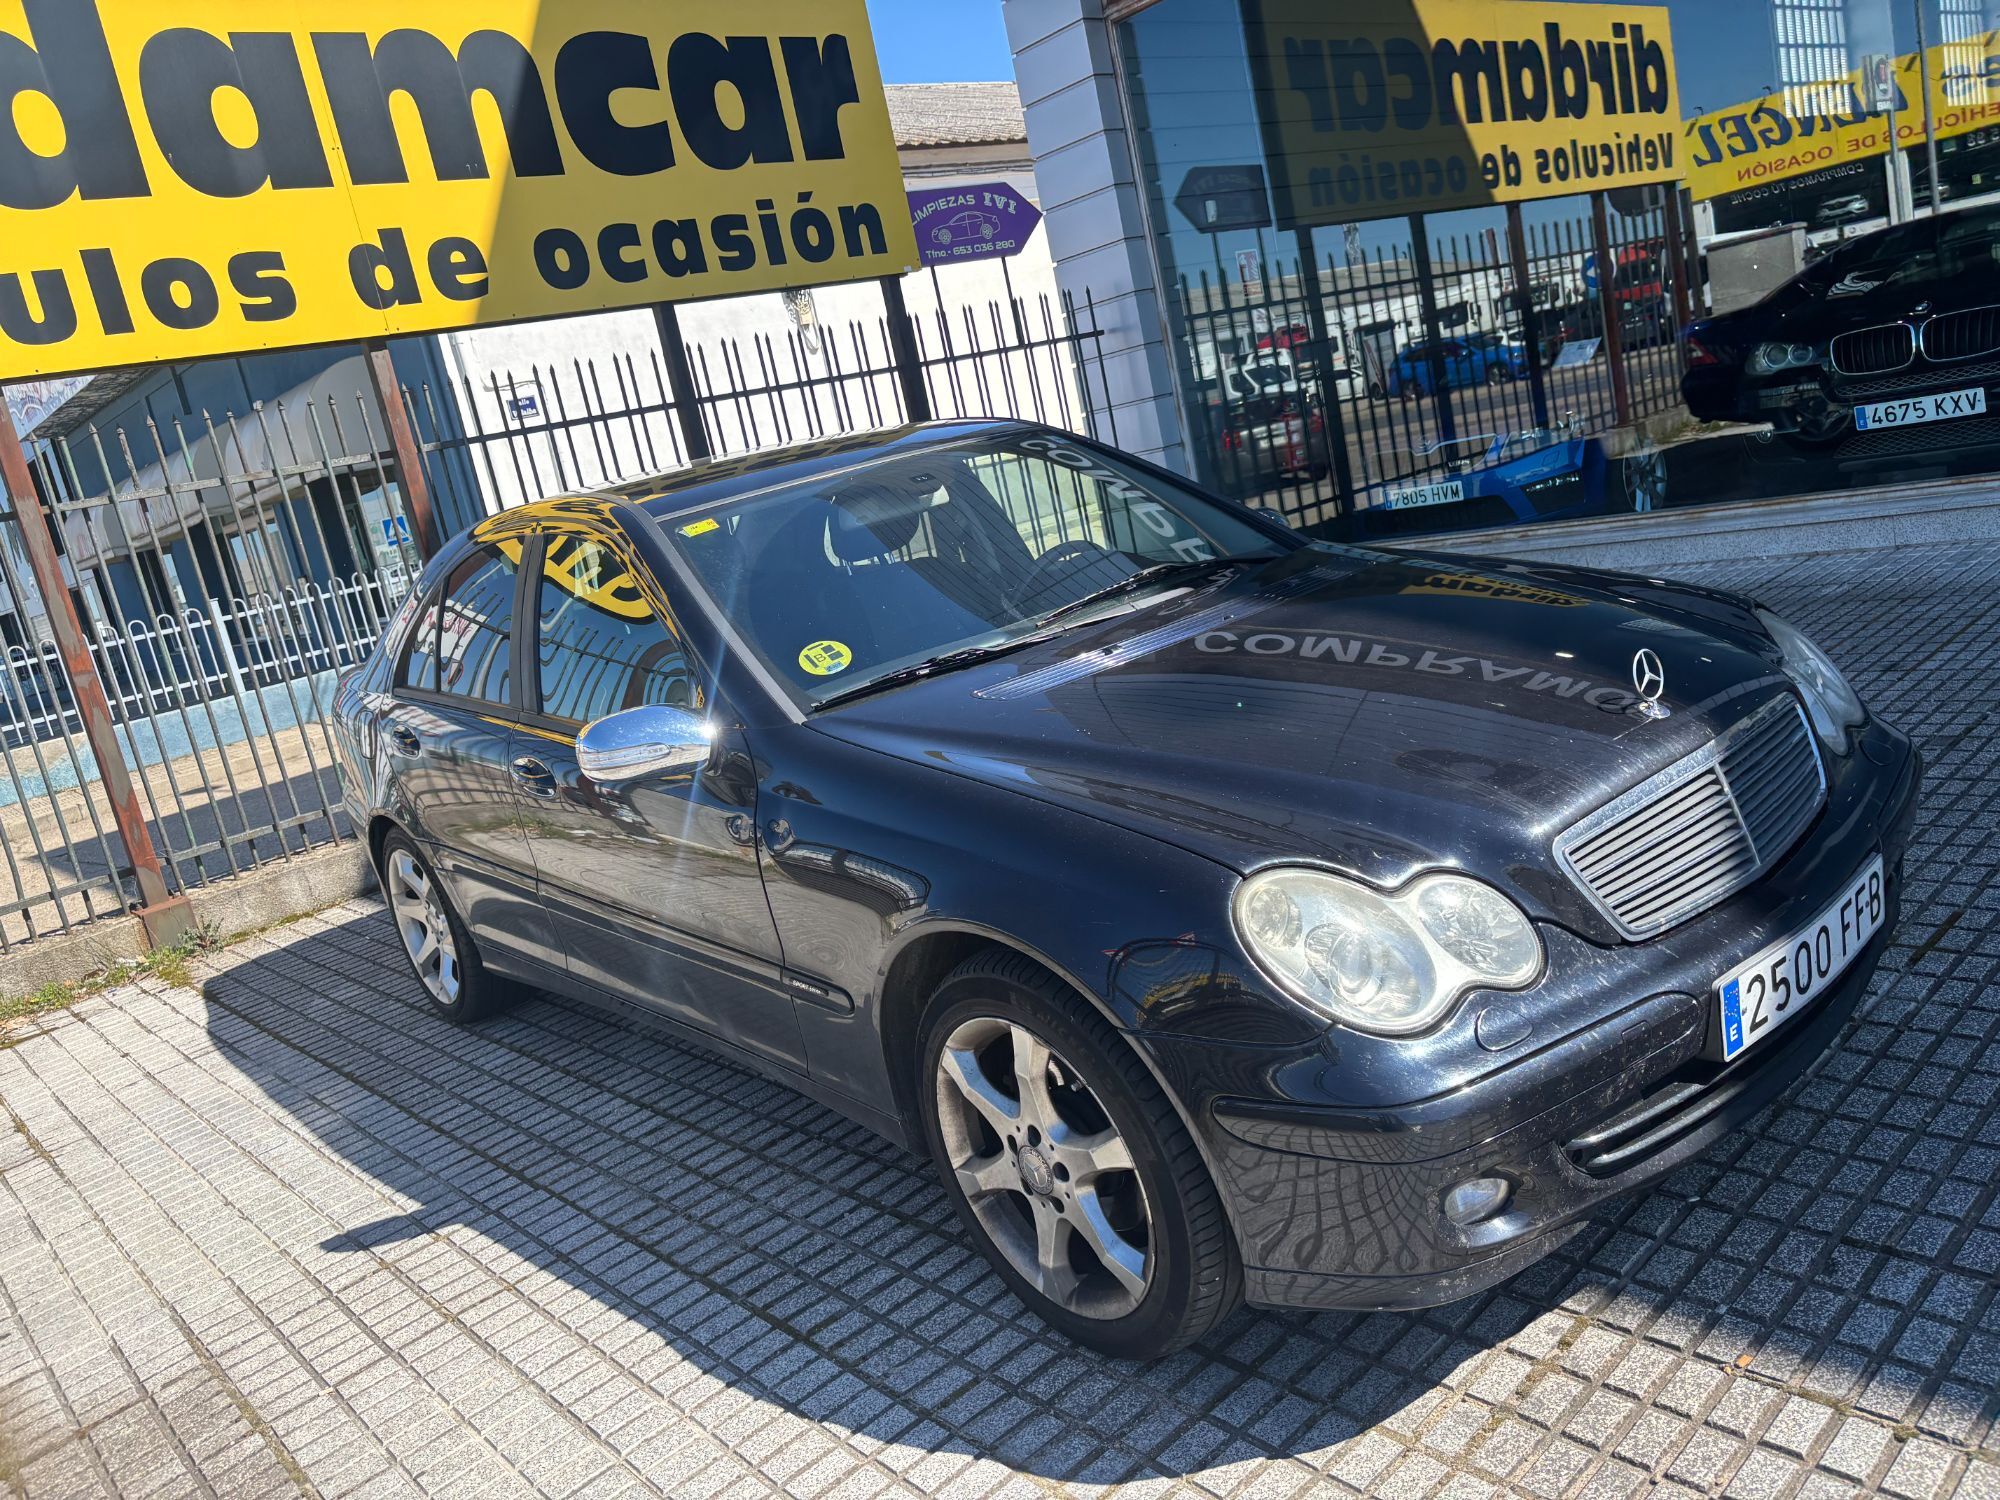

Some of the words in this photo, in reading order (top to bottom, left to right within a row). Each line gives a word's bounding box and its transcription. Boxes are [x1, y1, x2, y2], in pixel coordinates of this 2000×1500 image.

[0, 0, 860, 210] damcar
[983, 192, 1017, 215] IVI
[953, 246, 972, 255] 653
[974, 242, 994, 252] 036
[995, 240, 1015, 250] 280
[0, 247, 297, 345] ulos
[348, 227, 489, 310] de
[534, 191, 888, 290] ocasión
[1872, 401, 1926, 425] 4675
[1934, 392, 1978, 416] KXV
[1393, 489, 1427, 507] 7805
[1431, 484, 1459, 502] HVM
[1729, 1023, 1738, 1042] E
[1747, 924, 1831, 1034] 2500
[1840, 871, 1881, 957] FFB
